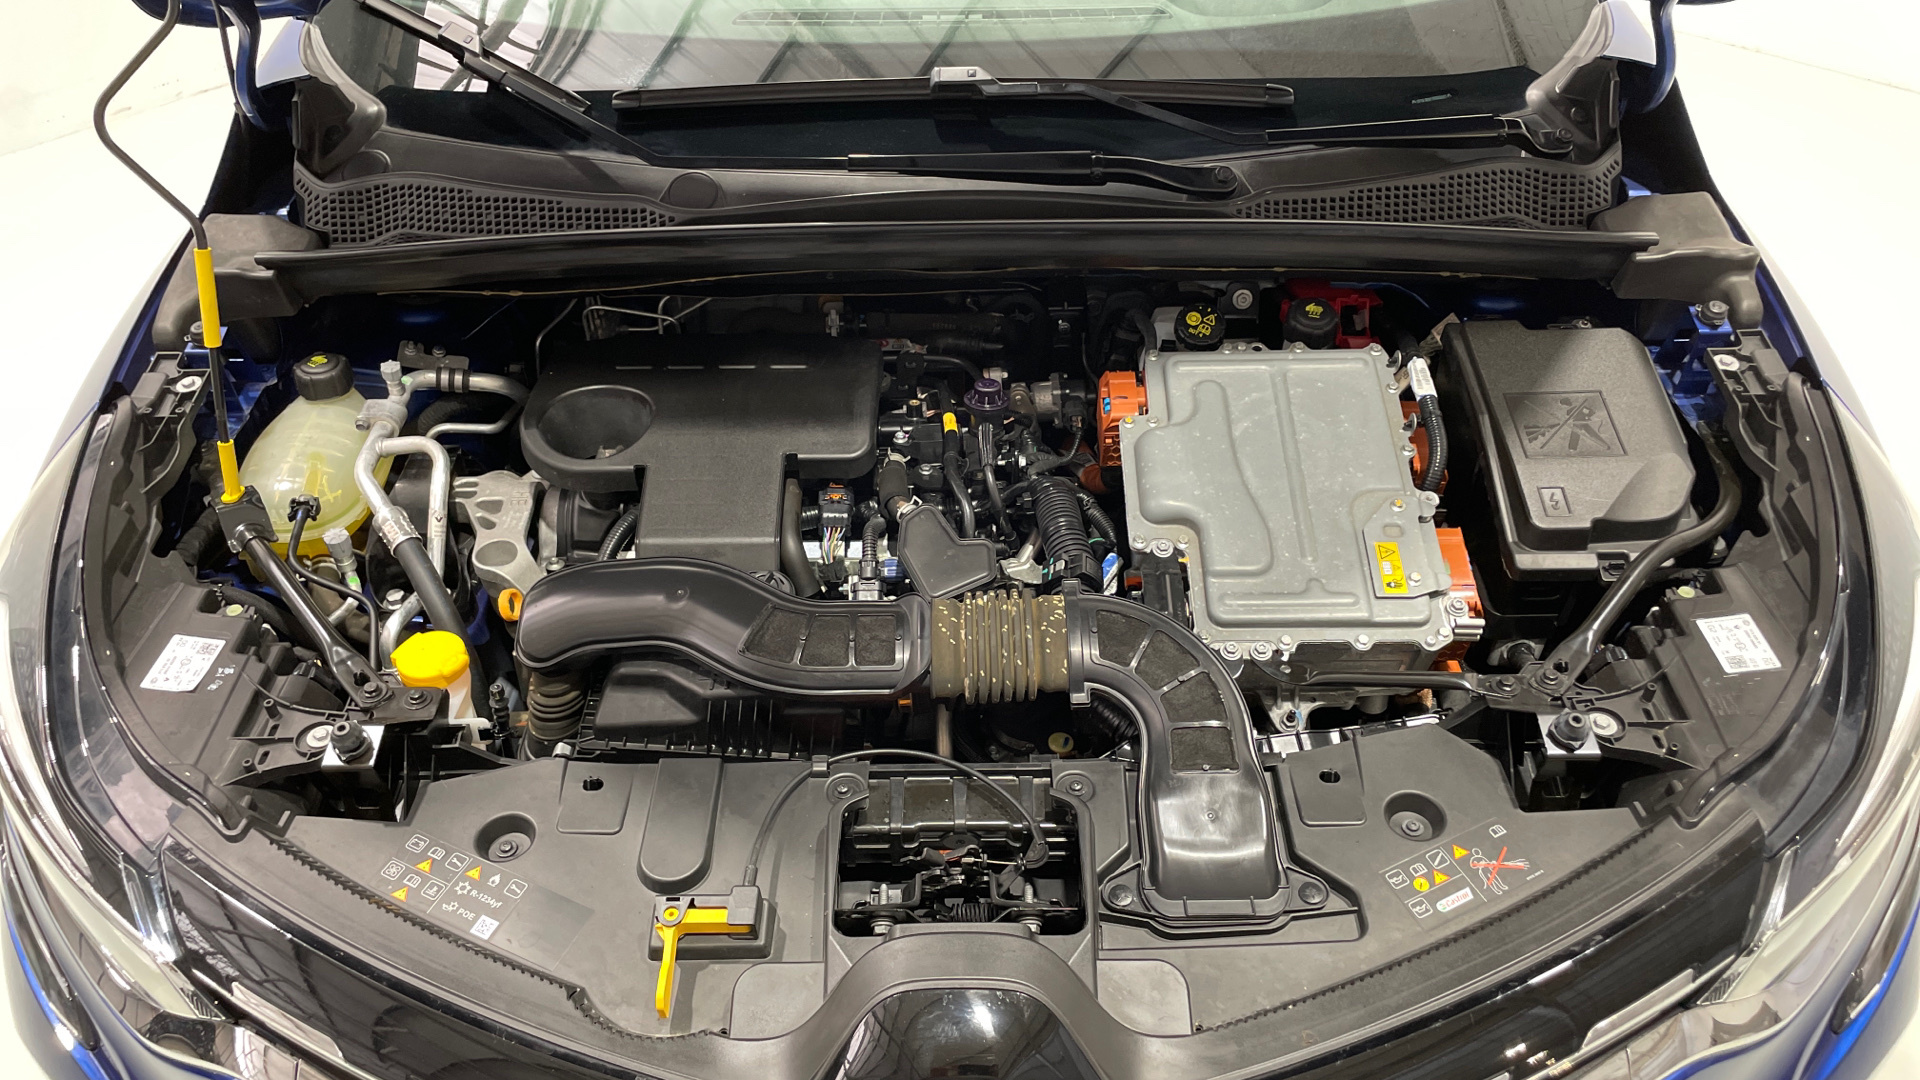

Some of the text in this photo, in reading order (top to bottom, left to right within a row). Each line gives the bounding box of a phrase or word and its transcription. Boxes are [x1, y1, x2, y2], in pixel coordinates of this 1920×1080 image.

[469, 889, 503, 908] R-1234yf
[1445, 891, 1470, 908] Castrol
[456, 907, 476, 921] POE
